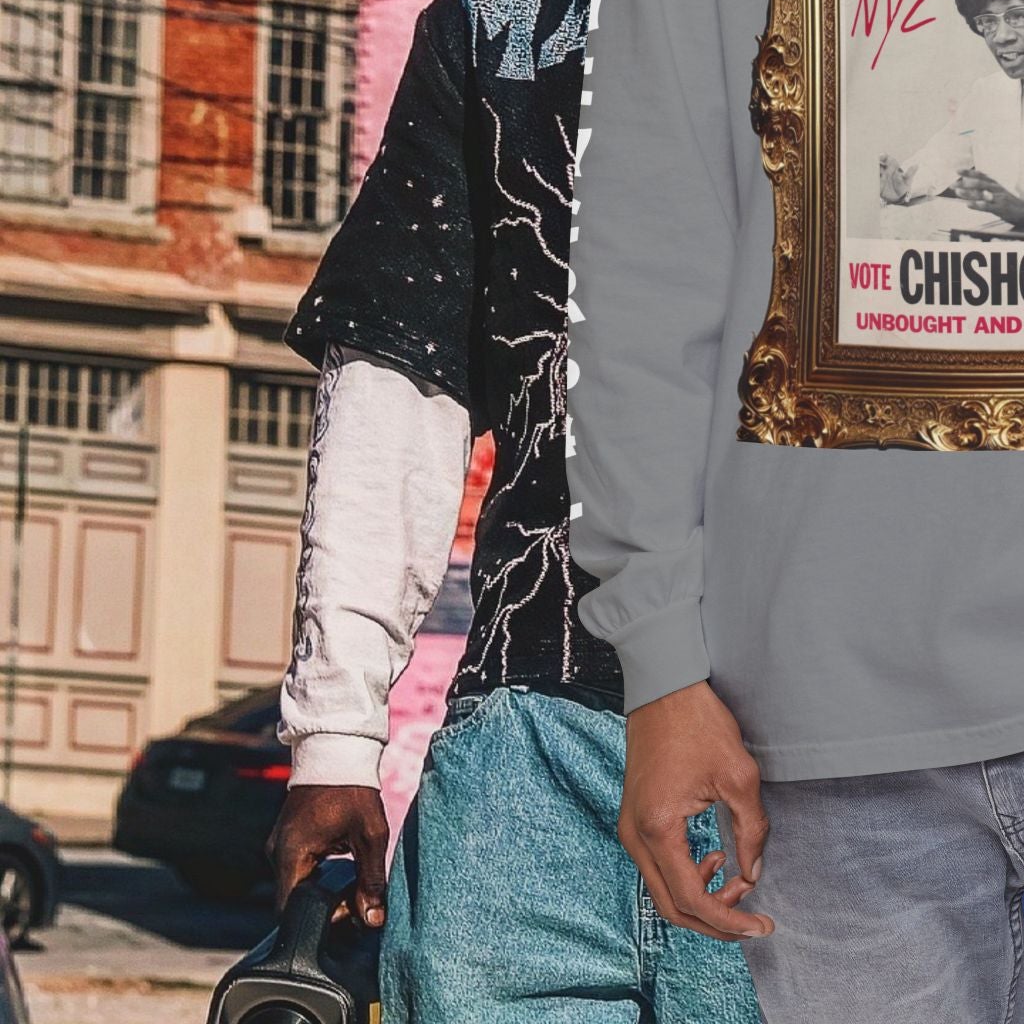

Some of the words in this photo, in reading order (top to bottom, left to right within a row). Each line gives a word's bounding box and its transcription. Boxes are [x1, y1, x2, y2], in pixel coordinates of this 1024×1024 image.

[849, 262, 892, 290] VOTE
[856, 312, 967, 334] UNBOUGHT
[974, 316, 1023, 334] AND
